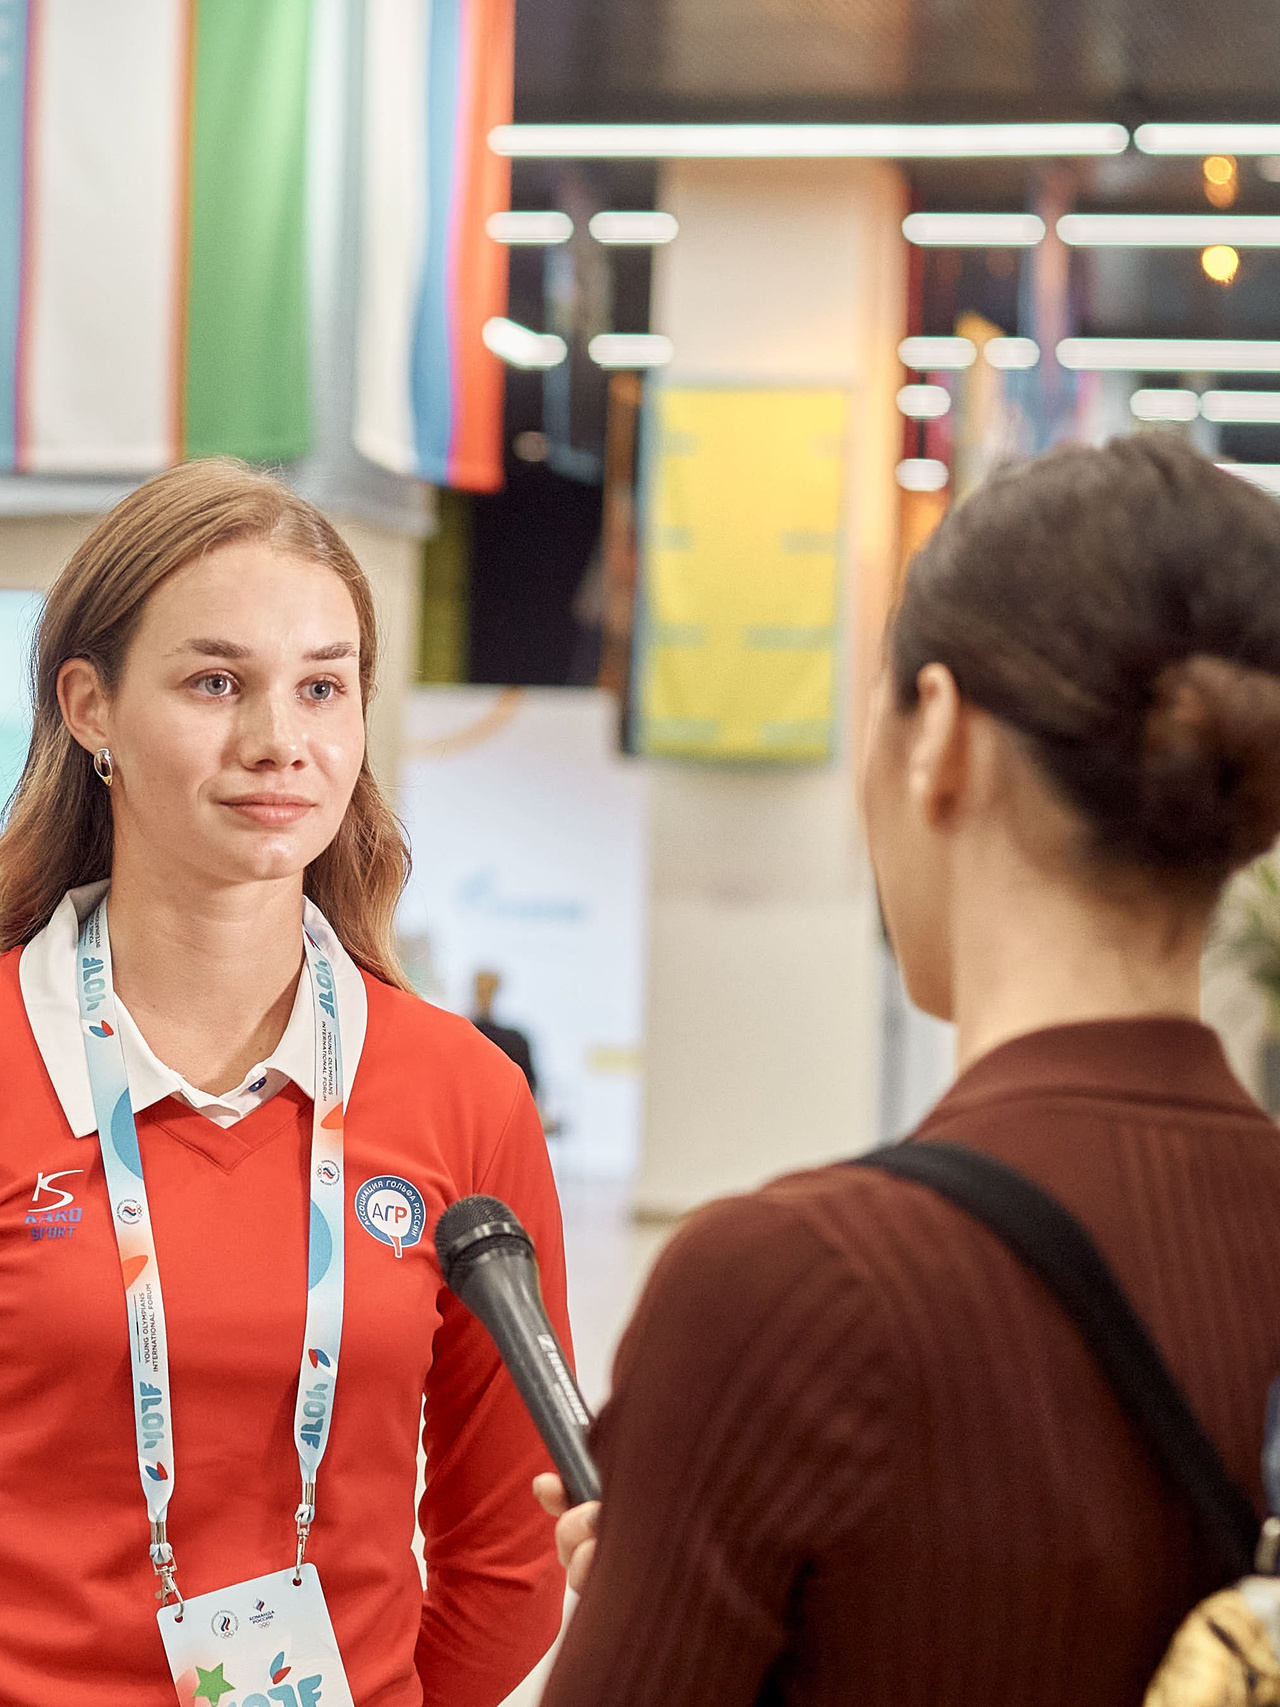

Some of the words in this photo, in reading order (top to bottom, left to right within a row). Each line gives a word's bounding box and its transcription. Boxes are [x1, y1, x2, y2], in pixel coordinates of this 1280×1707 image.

[359, 1180, 384, 1226] АССОЦИАЦИЯ
[386, 1180, 417, 1202] ГОЛЬФА
[411, 1202, 422, 1237] РОССИИ
[372, 1202, 408, 1224] АГР
[31, 1226, 76, 1241] SPORT
[139, 1292, 149, 1334] OLYMPIANS
[146, 1283, 154, 1310] FORUM
[148, 1312, 159, 1373] INTERNATIONAL
